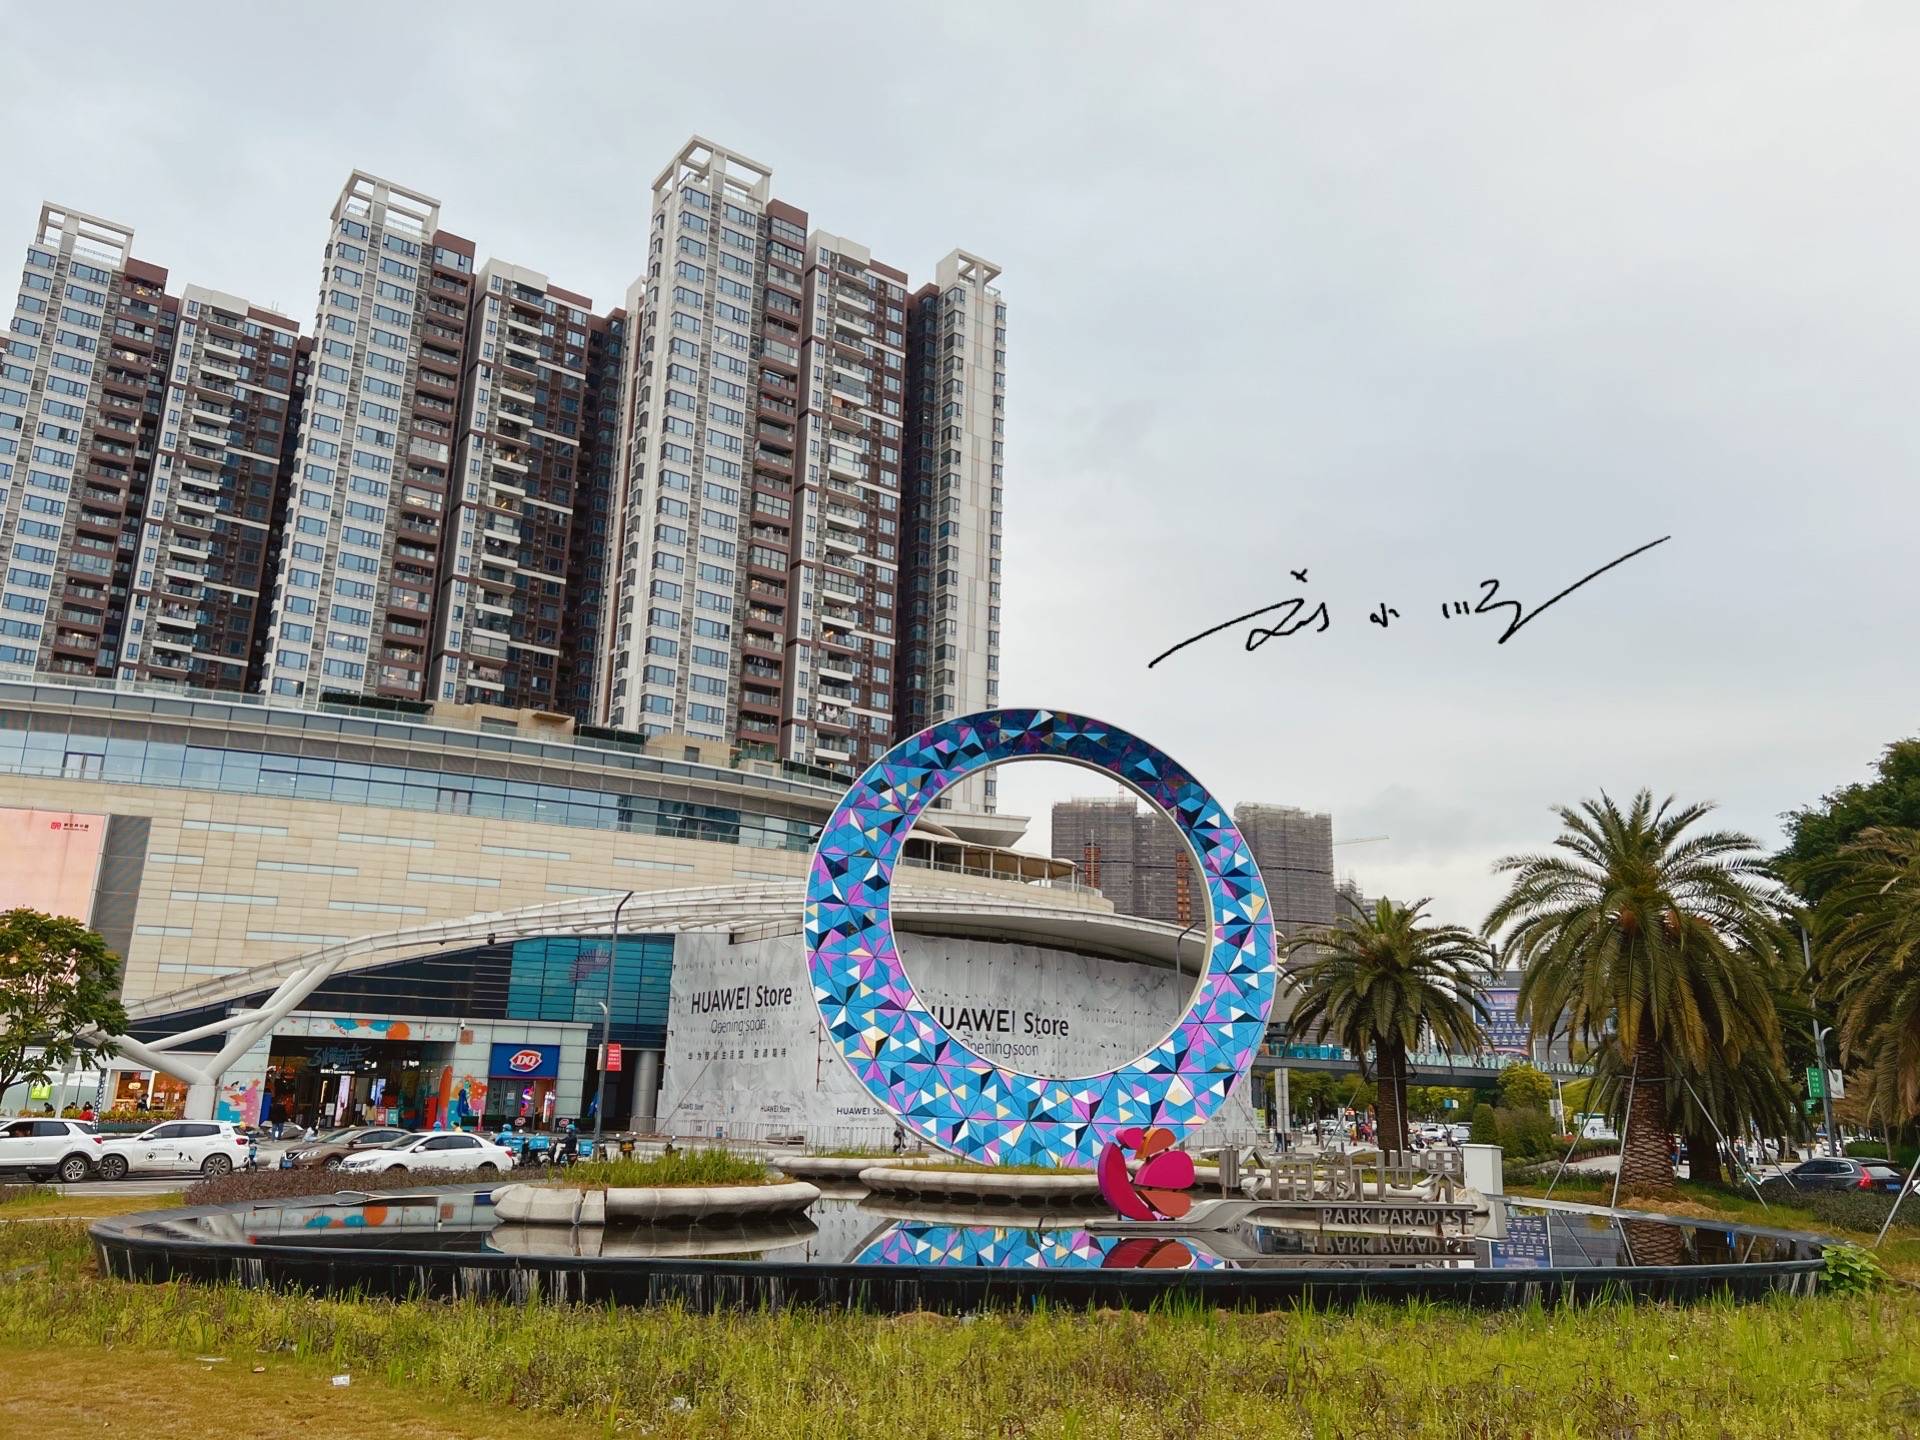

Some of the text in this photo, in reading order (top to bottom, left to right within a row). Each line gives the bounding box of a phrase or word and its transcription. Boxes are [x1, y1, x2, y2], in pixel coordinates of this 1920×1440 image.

[691, 985, 792, 1014] HUAWEI Store
[711, 1019, 744, 1036] Opening
[1024, 1012, 1069, 1036] Store
[1012, 1043, 1039, 1056] soon
[516, 1055, 536, 1066] DQ
[836, 1107, 870, 1115] HUAWEI
[1323, 1208, 1474, 1225] PARK PARADISE
